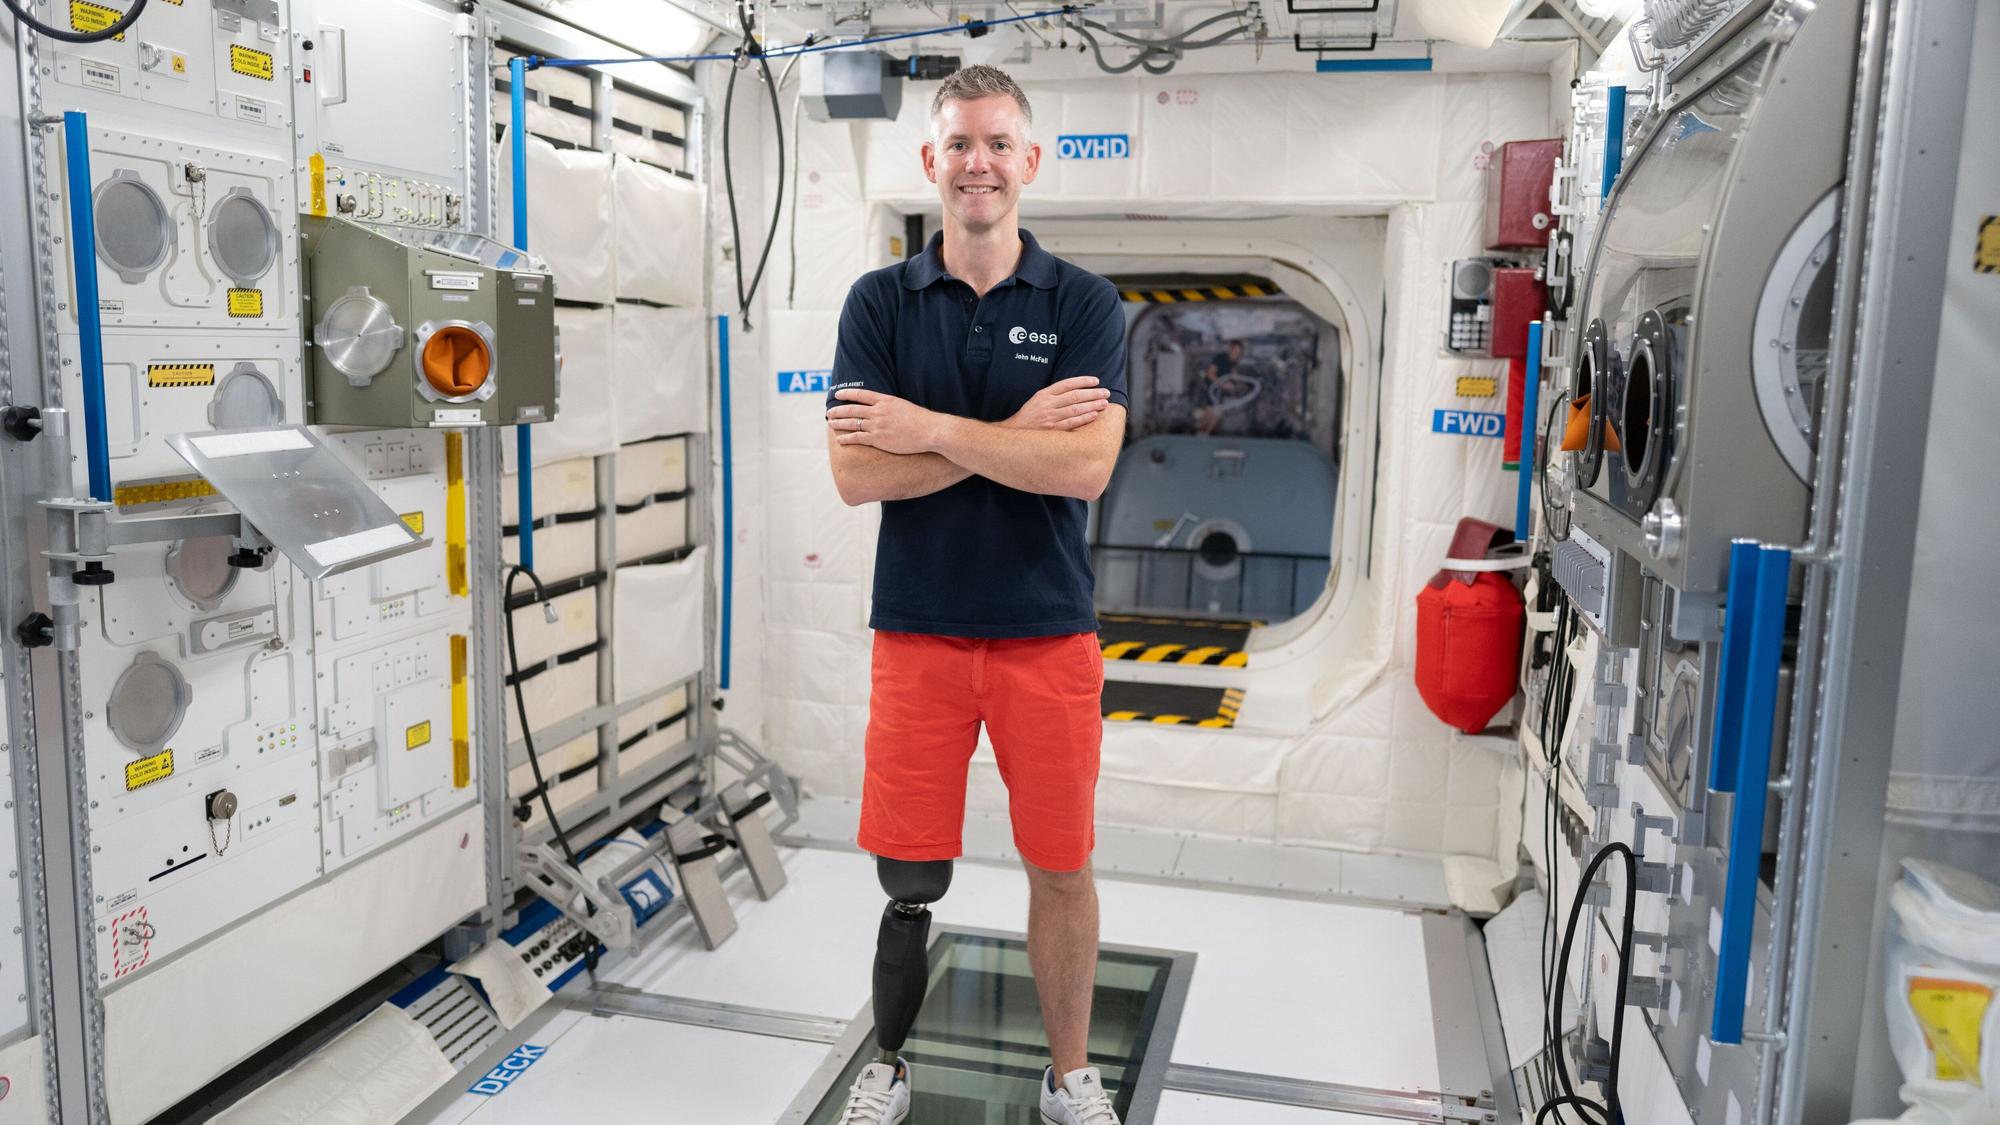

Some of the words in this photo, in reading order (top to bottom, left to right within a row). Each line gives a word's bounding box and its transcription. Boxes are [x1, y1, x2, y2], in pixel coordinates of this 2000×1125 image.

[80, 8, 105, 19] WARNING
[75, 14, 90, 23] COLD
[90, 18, 107, 27] INSIDE
[234, 57, 247, 65] COLD
[238, 52, 258, 61] WARNING
[1058, 138, 1127, 159] OVHD
[1029, 332, 1057, 345] esa
[1015, 352, 1029, 360] John
[1030, 355, 1049, 363] McFall
[789, 372, 832, 391] AFT
[1442, 411, 1500, 435] FWD
[134, 760, 156, 771] WARNING
[130, 771, 144, 780] COLD
[143, 766, 158, 775] INSIDE
[472, 1043, 545, 1093] DECK
